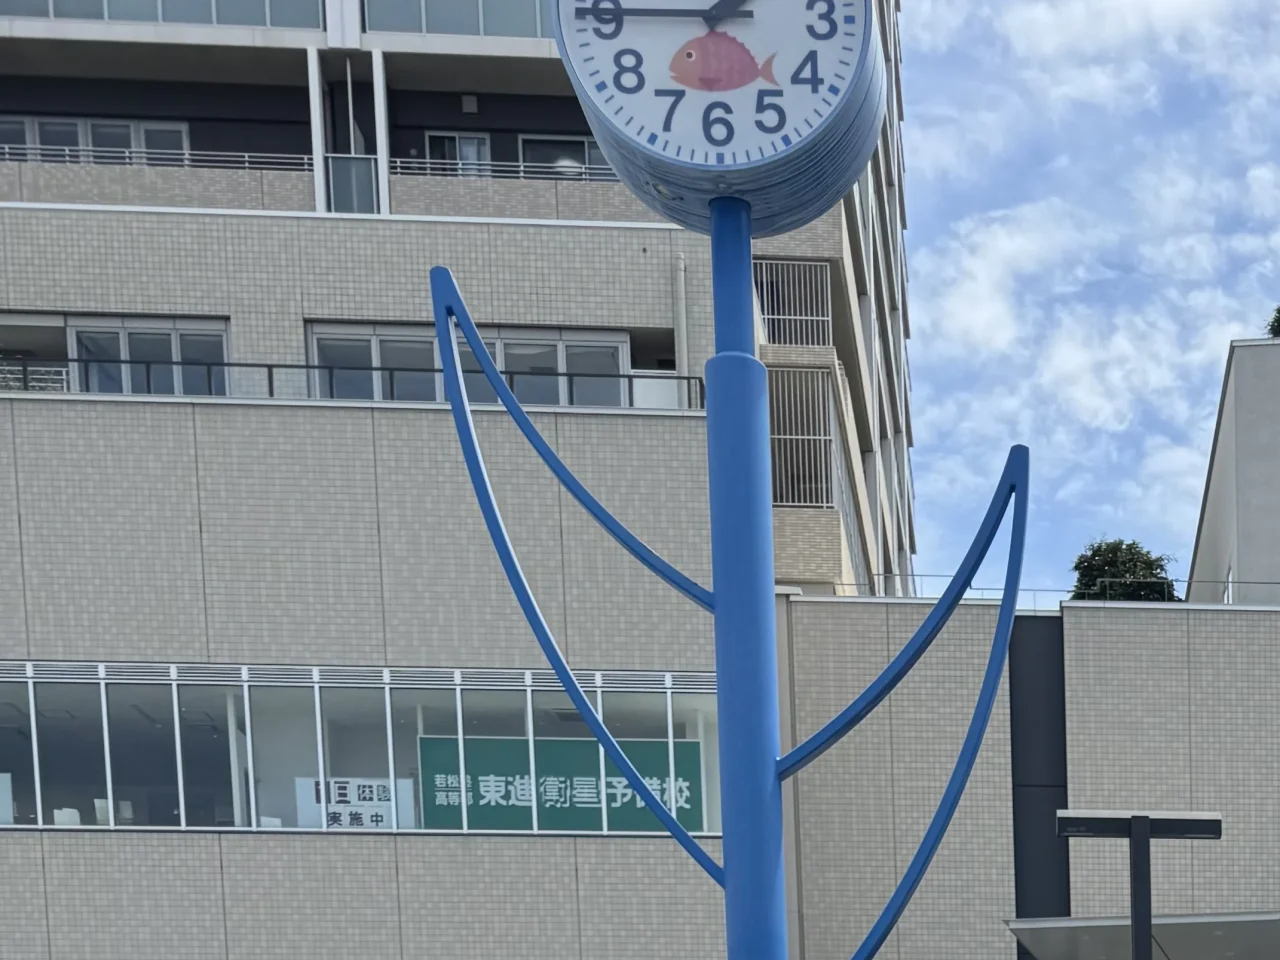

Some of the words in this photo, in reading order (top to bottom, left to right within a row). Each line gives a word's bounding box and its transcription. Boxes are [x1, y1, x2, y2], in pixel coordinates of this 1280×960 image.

[592, 0, 624, 40] 9
[805, 0, 838, 41] 3
[613, 48, 646, 94] 8
[790, 50, 824, 94] 4
[654, 89, 686, 132] 7
[702, 101, 735, 147] 6
[755, 89, 787, 134] 5
[328, 812, 384, 827] 実施中
